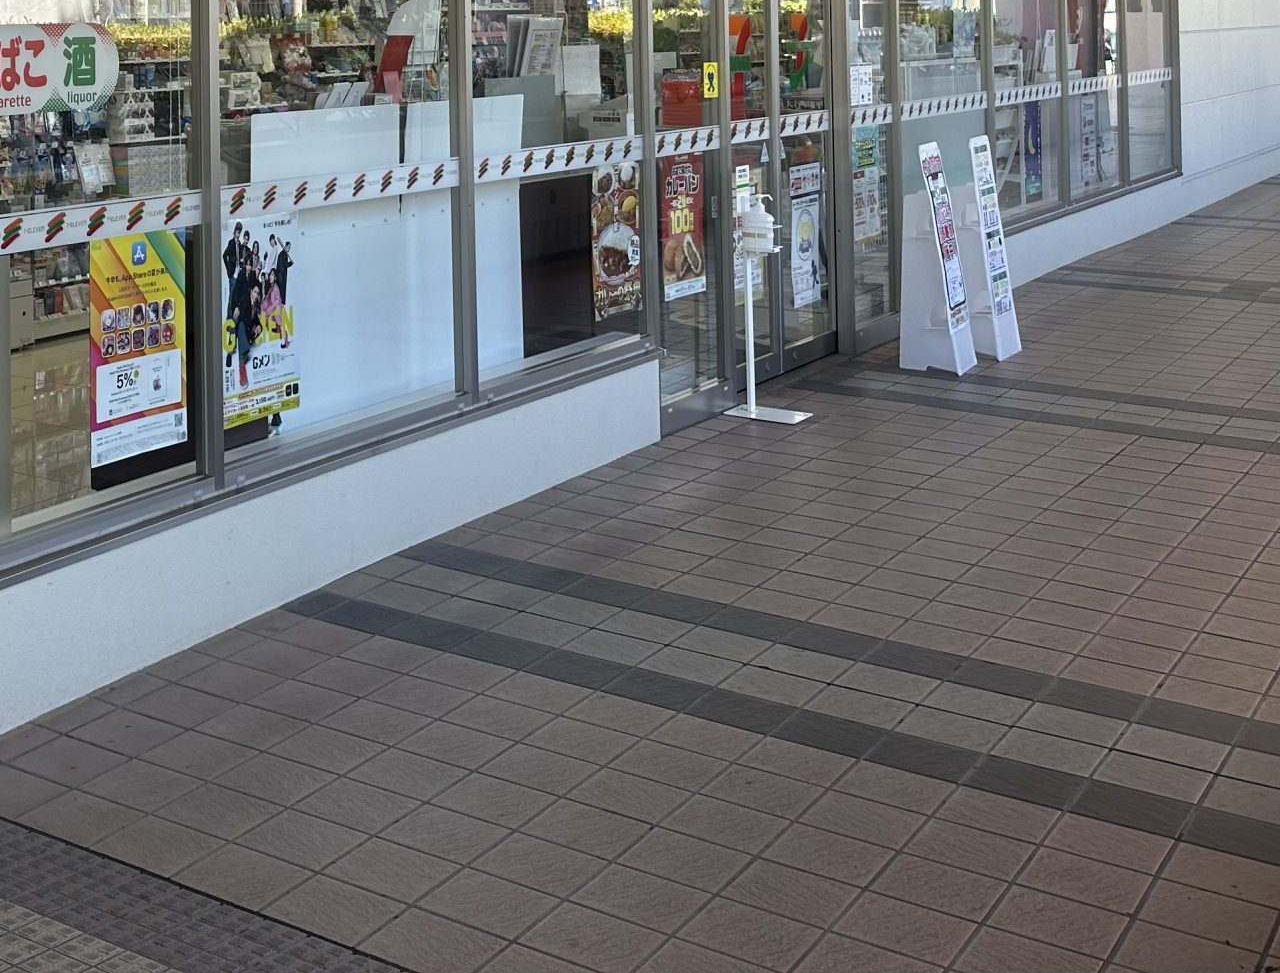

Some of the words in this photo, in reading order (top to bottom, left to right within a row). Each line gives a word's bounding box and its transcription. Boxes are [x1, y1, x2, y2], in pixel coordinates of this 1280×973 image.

[63, 36, 96, 87] 酒
[67, 91, 98, 105] liquor
[252, 355, 271, 369] Gメン
[116, 371, 134, 389] 5%
